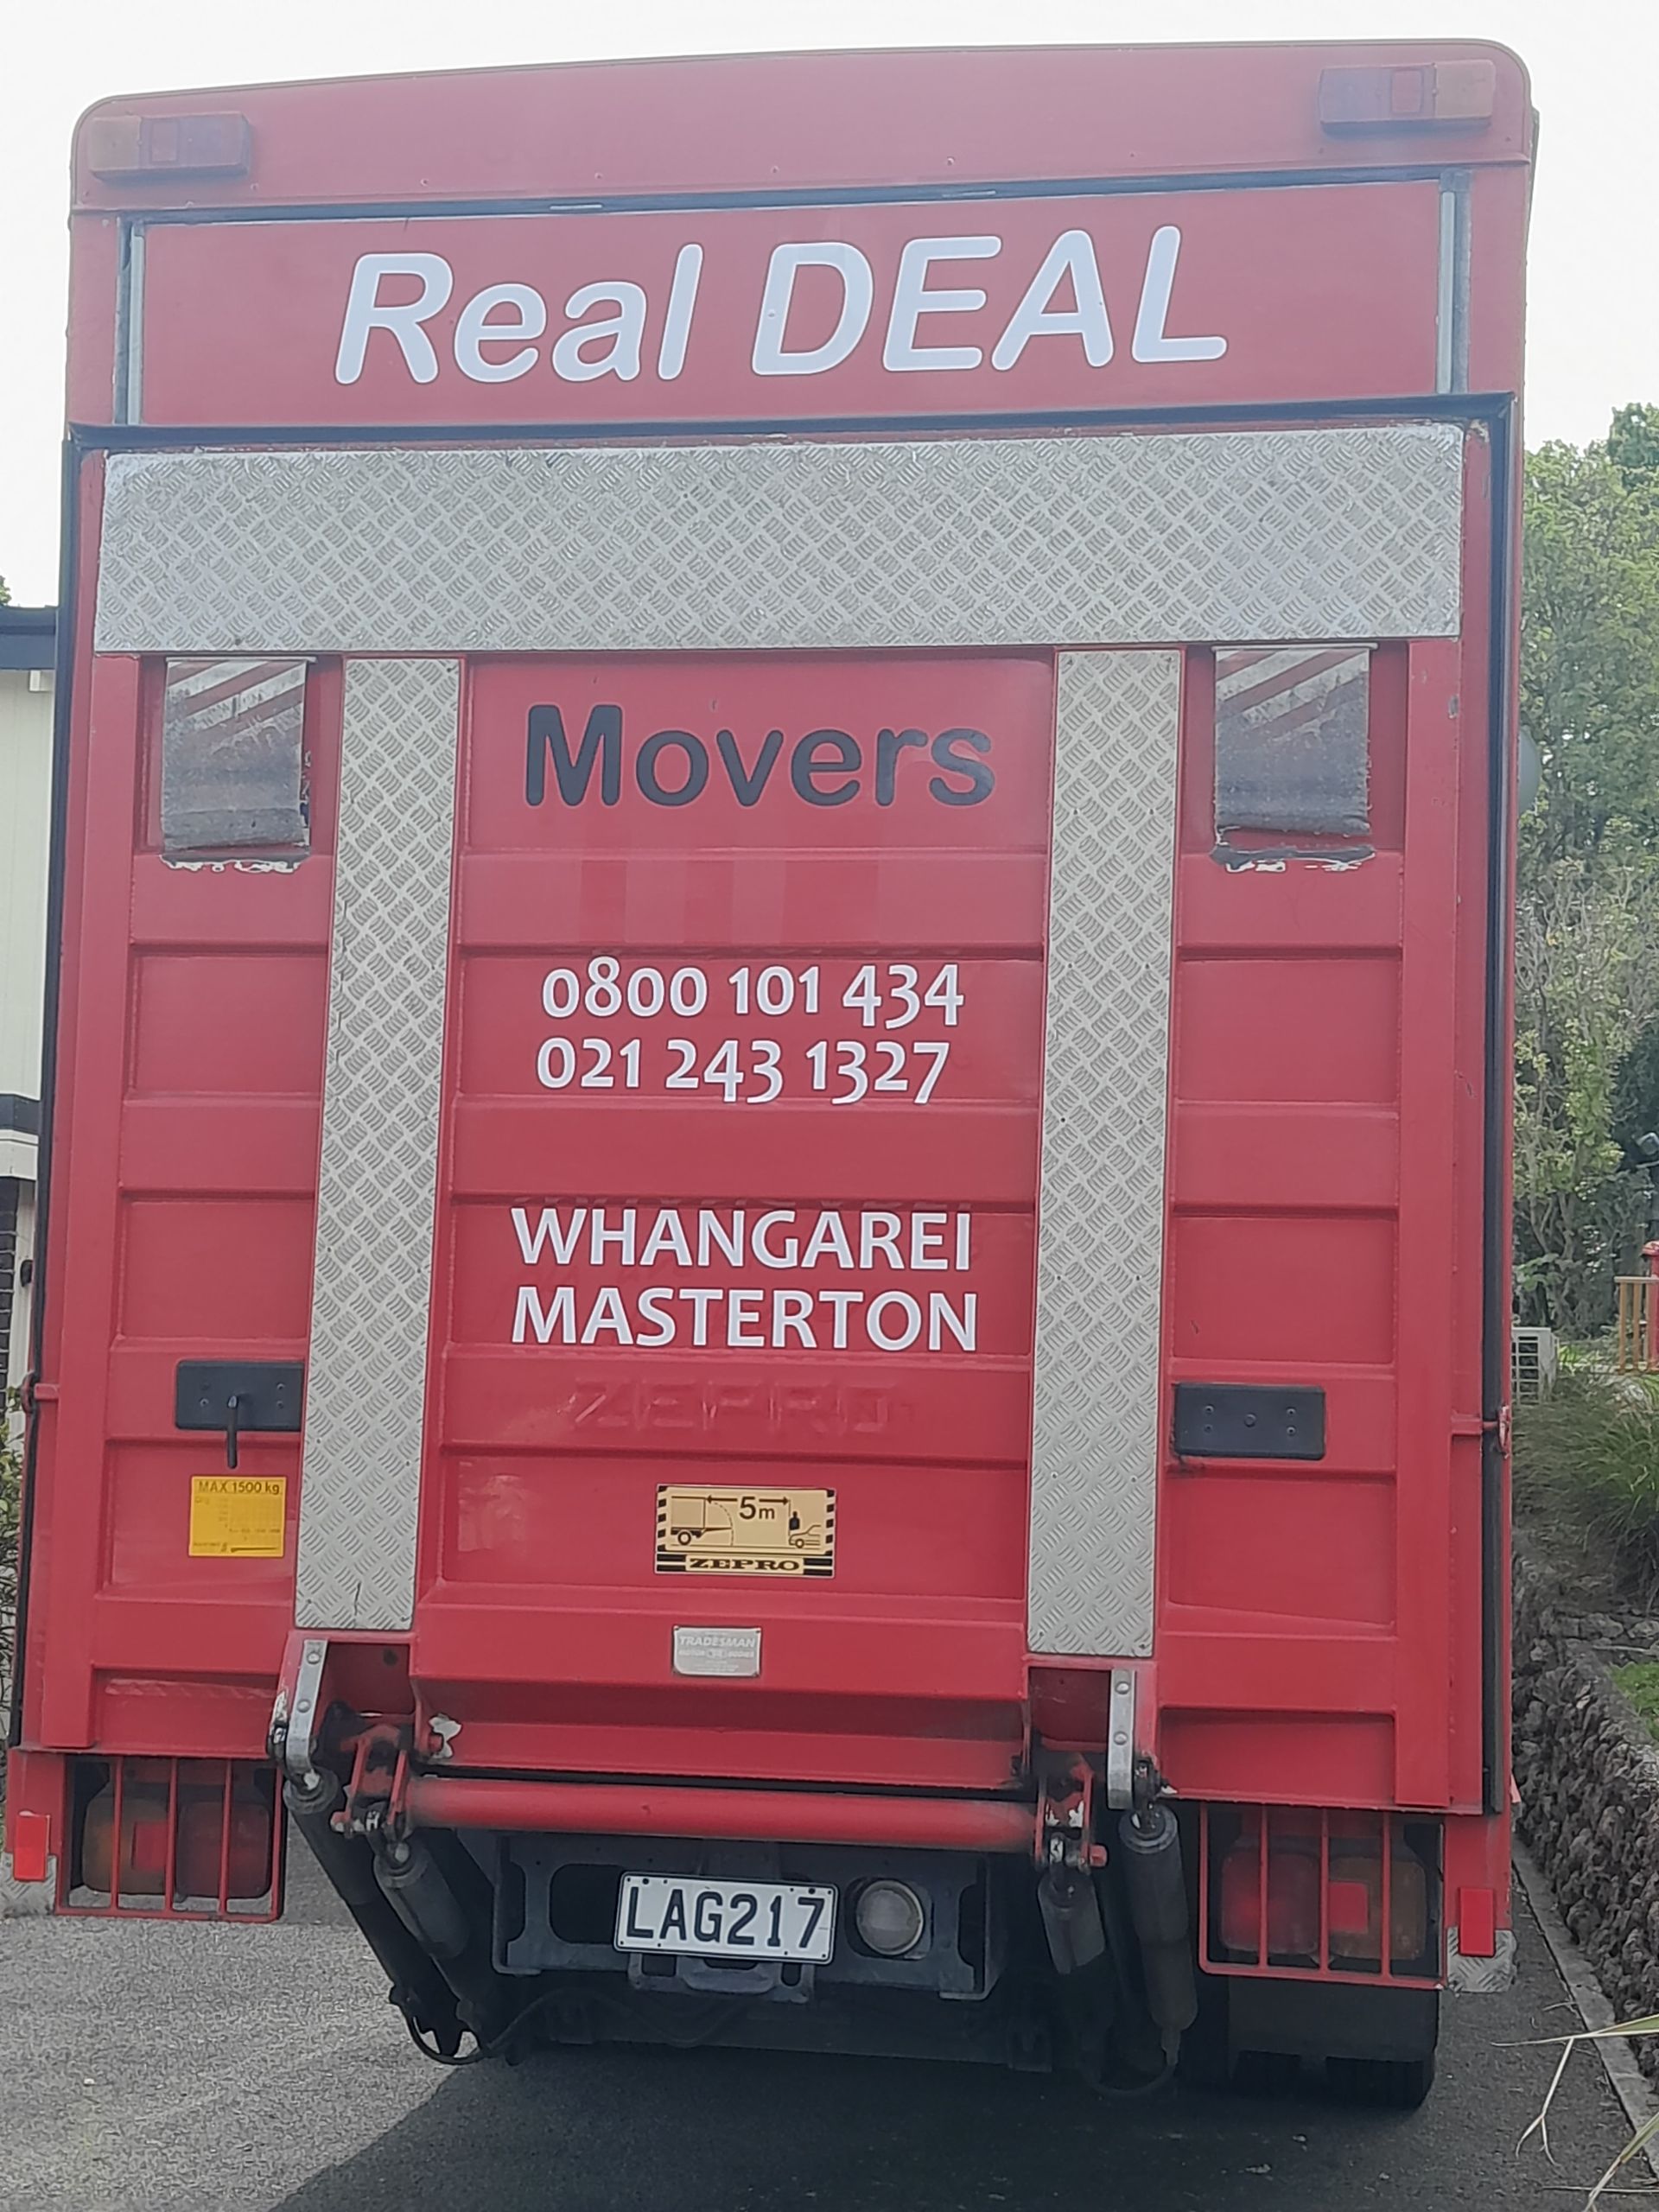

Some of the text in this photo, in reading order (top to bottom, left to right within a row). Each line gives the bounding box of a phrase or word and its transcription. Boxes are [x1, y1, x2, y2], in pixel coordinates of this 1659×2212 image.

[335, 226, 1228, 384] Real DEAL
[525, 704, 996, 807] Movers
[542, 955, 964, 1029] 0800 101 434
[537, 1037, 950, 1105] 021 243 1327
[511, 1207, 970, 1271] WHANGAREI
[511, 1286, 977, 1351] MASTERTON
[199, 1480, 280, 1495] MAX 1500 kg
[690, 1557, 800, 1571] ZEPRO
[679, 1636, 756, 1648] TRADESMAN
[626, 1886, 825, 1948] LAG217
